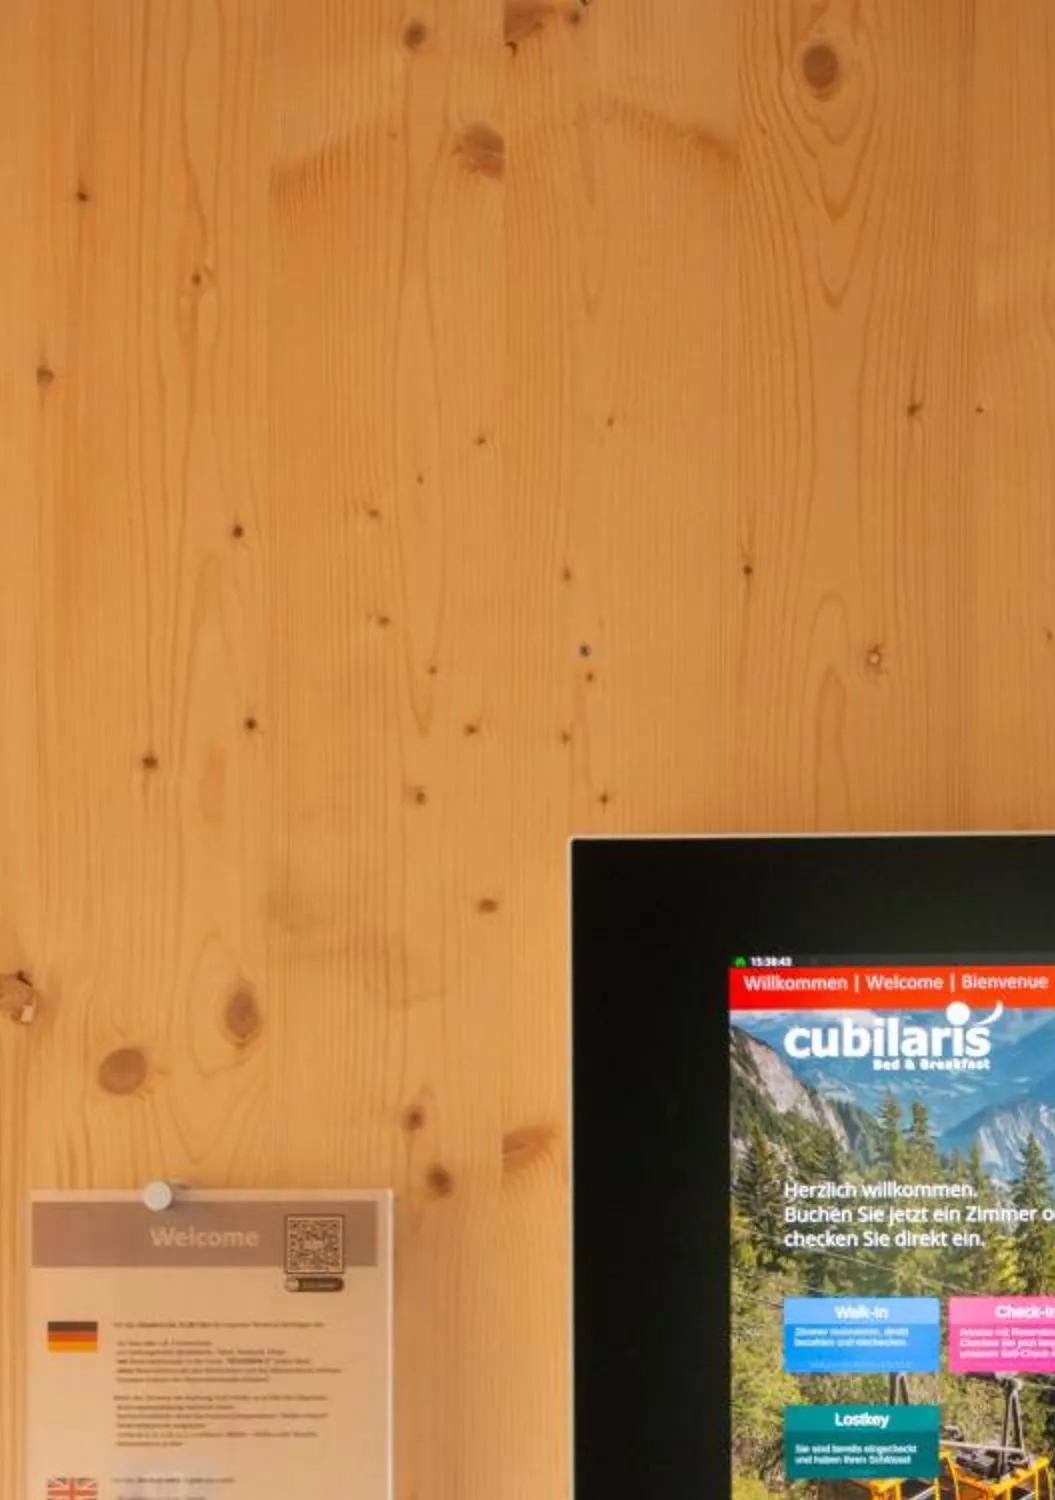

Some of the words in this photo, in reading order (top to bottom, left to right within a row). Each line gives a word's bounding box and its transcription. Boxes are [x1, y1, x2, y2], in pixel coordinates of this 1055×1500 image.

[743, 974, 849, 991] Willkommen
[865, 974, 944, 990] Welcome
[961, 973, 1049, 990] Bienvenue
[783, 1002, 995, 1059] cubilaris
[873, 1058, 900, 1071] Bed
[920, 1057, 991, 1071] Breakfast
[784, 1181, 856, 1198] Herzlich
[861, 1181, 978, 1198] willkommen.
[784, 1206, 851, 1223] Buchen
[857, 1206, 883, 1223] Sie
[887, 1206, 928, 1226] jetzt
[933, 1206, 961, 1222] ein
[965, 1206, 1035, 1222] Zimmer
[149, 1226, 261, 1249] Welcome
[784, 1231, 858, 1248] checken
[863, 1231, 889, 1247] Sie
[895, 1231, 948, 1247] direkt
[952, 1231, 985, 1247] ein.
[834, 1411, 890, 1430] Lostkey
